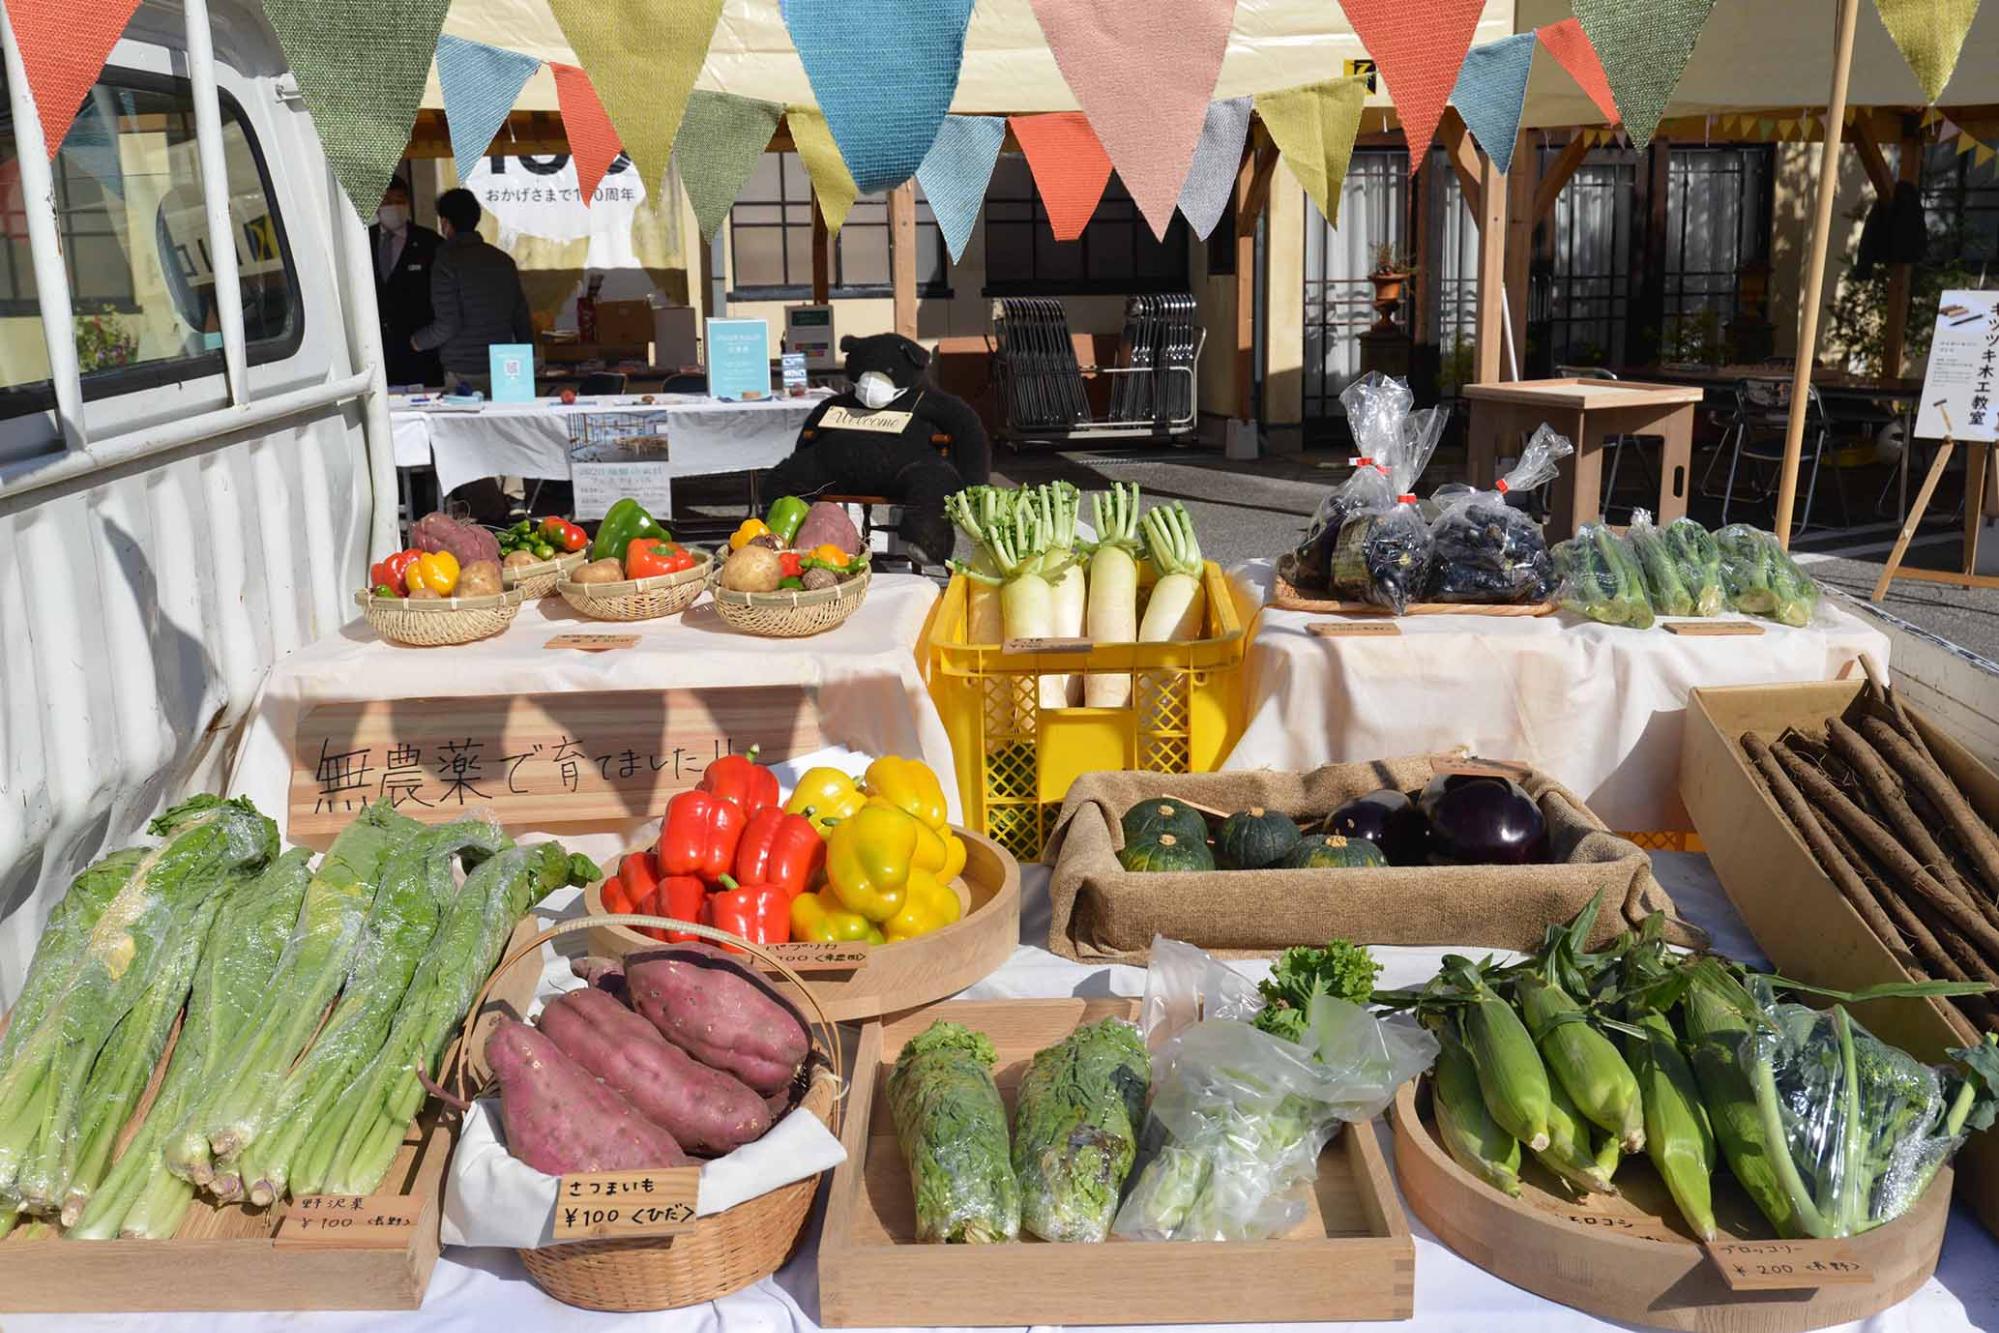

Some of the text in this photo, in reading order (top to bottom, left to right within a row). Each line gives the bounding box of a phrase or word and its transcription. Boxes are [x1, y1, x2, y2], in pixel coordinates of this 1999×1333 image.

[486, 187, 635, 203] おかげさまで10周年
[833, 410, 899, 428] Welcome
[569, 1178, 655, 1197] さつまいも
[565, 1207, 620, 1228] ¥100
